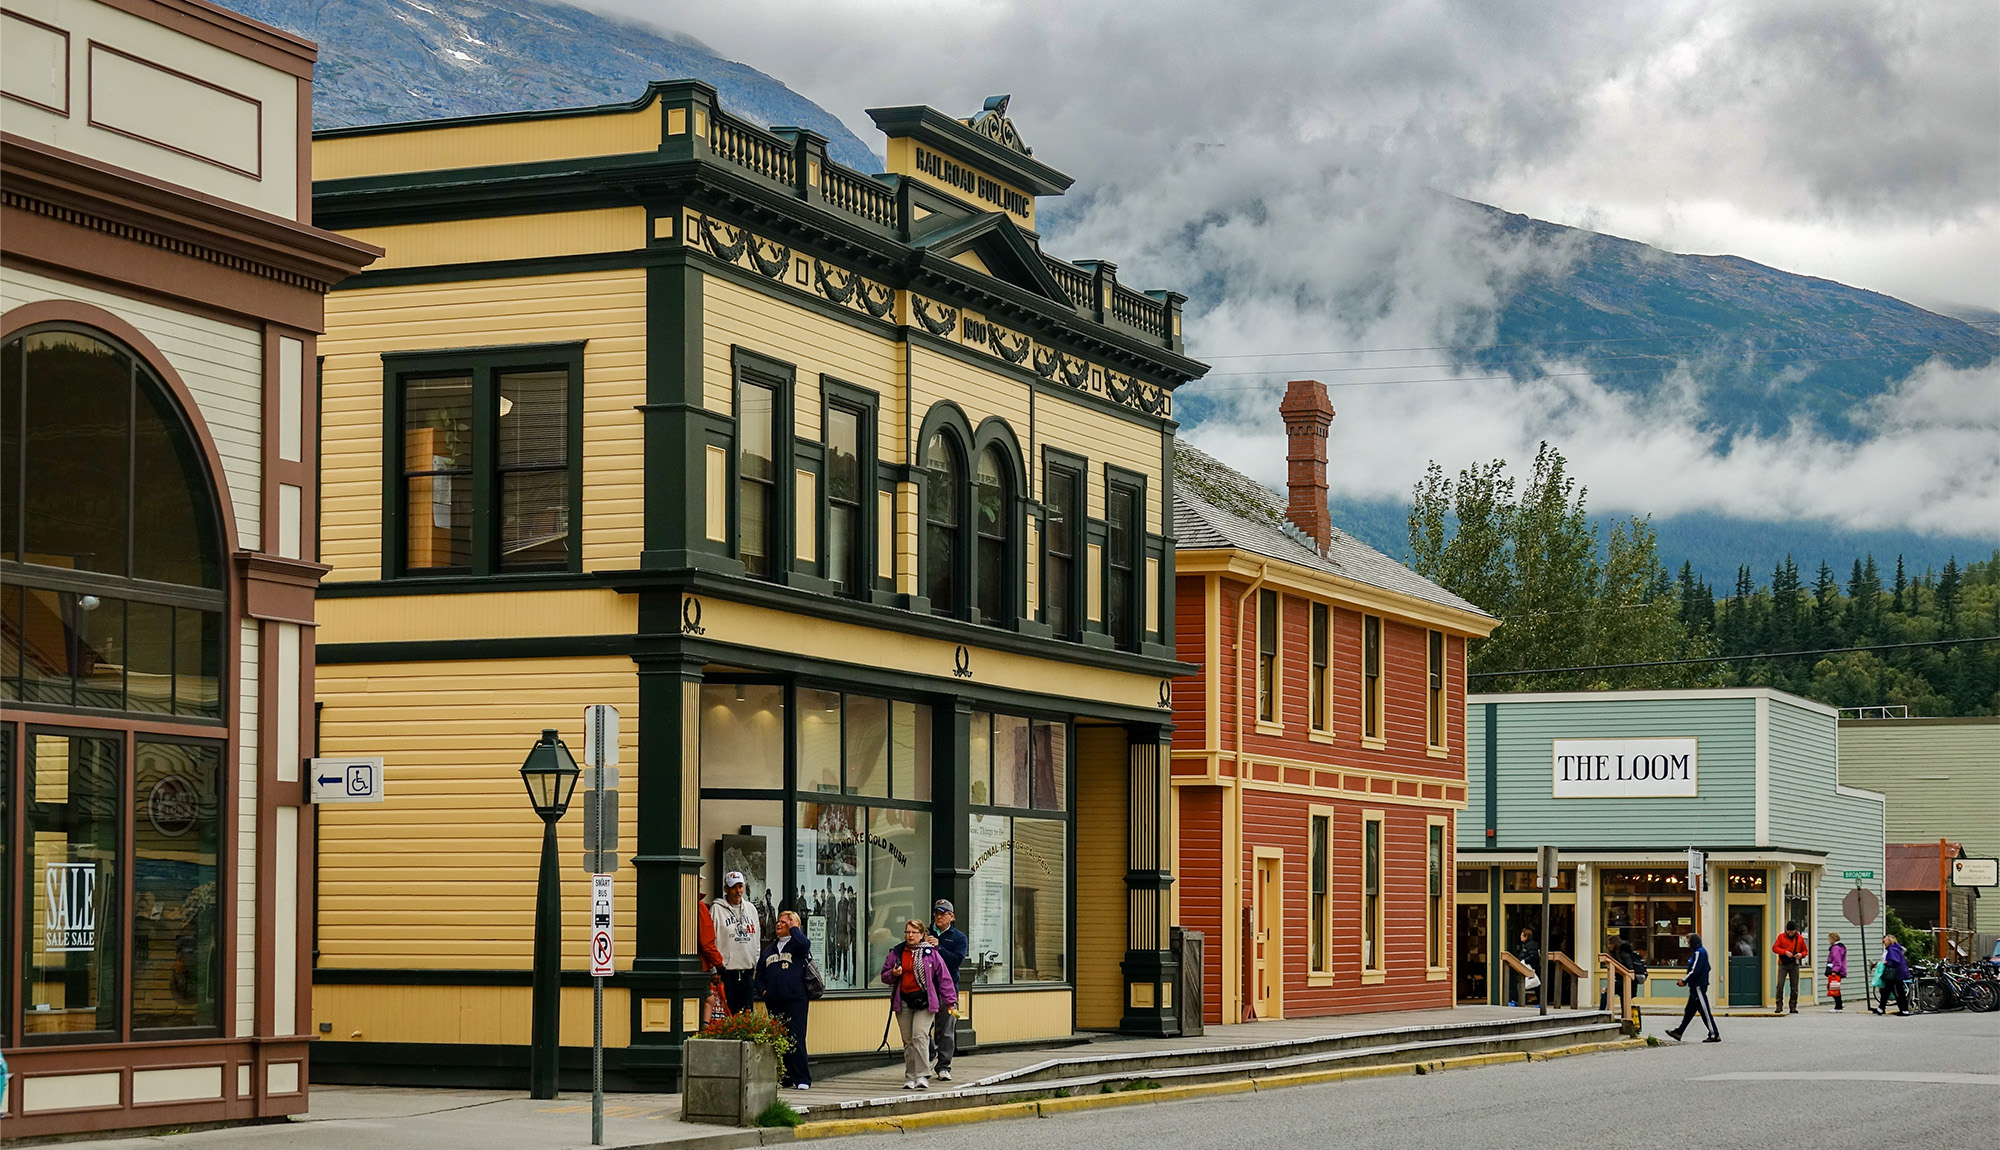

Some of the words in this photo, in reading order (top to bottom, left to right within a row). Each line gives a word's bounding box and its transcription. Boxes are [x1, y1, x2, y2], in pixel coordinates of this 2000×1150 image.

[916, 147, 976, 194] RAILROAD
[977, 175, 1030, 219] BUILDING
[963, 317, 987, 344] 1900
[1557, 755, 1610, 781] THE
[1615, 754, 1690, 781] LOOM
[868, 833, 887, 850] GOLD
[888, 842, 908, 868] RUSH
[971, 844, 1000, 873] NATIONAL
[595, 878, 610, 887] SMART
[598, 889, 608, 897] BUS
[46, 868, 96, 930] SALE
[46, 931, 70, 946] SALE
[71, 931, 95, 946] SALE
